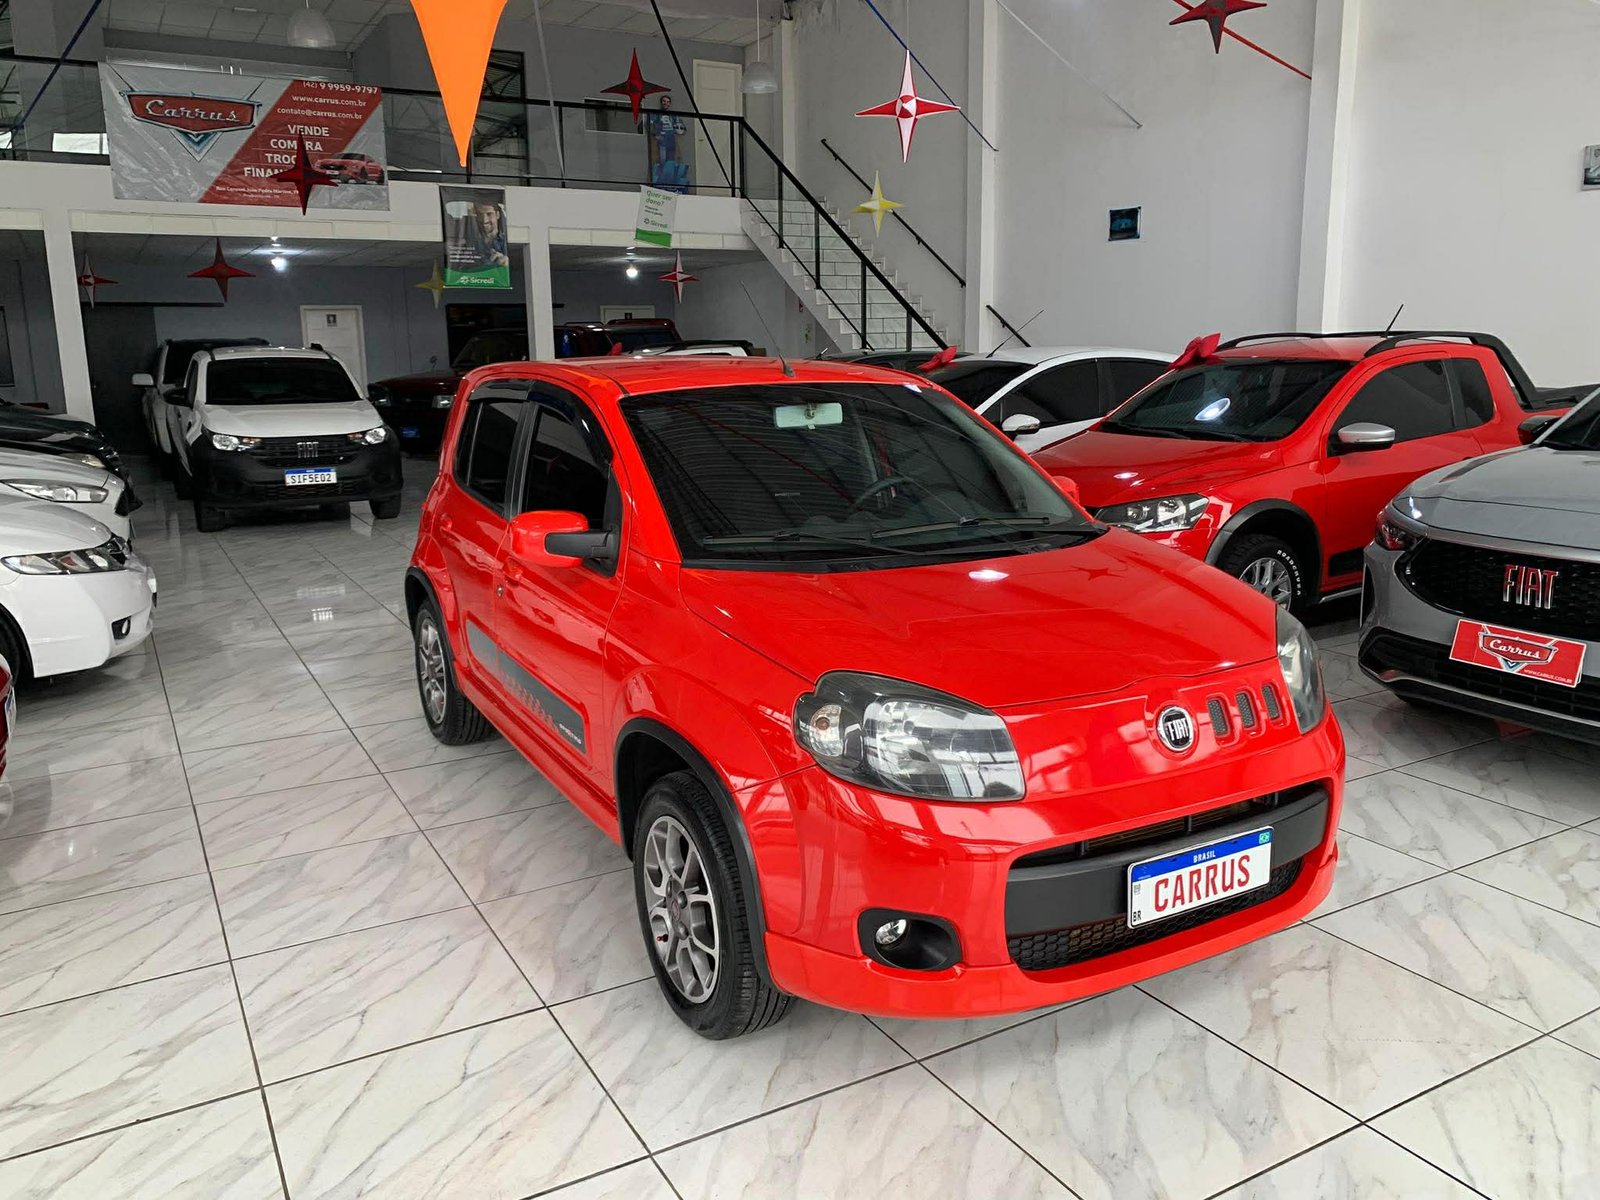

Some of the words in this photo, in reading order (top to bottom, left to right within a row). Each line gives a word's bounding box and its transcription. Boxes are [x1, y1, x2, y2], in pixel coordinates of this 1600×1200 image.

[319, 82, 327, 90] 9
[328, 83, 378, 94] 9959-9797
[292, 95, 366, 106] www.carrus.com.br
[145, 99, 241, 122] Carrus
[277, 107, 362, 119] contato@carrus.com.br
[287, 124, 330, 137] VENDE
[270, 139, 323, 152] COMRA
[265, 153, 297, 165] TROC
[297, 442, 319, 458] FIAT
[290, 473, 332, 484] SIF5E02
[1502, 564, 1559, 610] FIAT
[1489, 639, 1541, 660] Carrus
[1167, 717, 1190, 741] FIAT
[1193, 850, 1216, 863] BRASIL
[1154, 855, 1251, 912] CARRUS
[1133, 910, 1142, 922] BR
